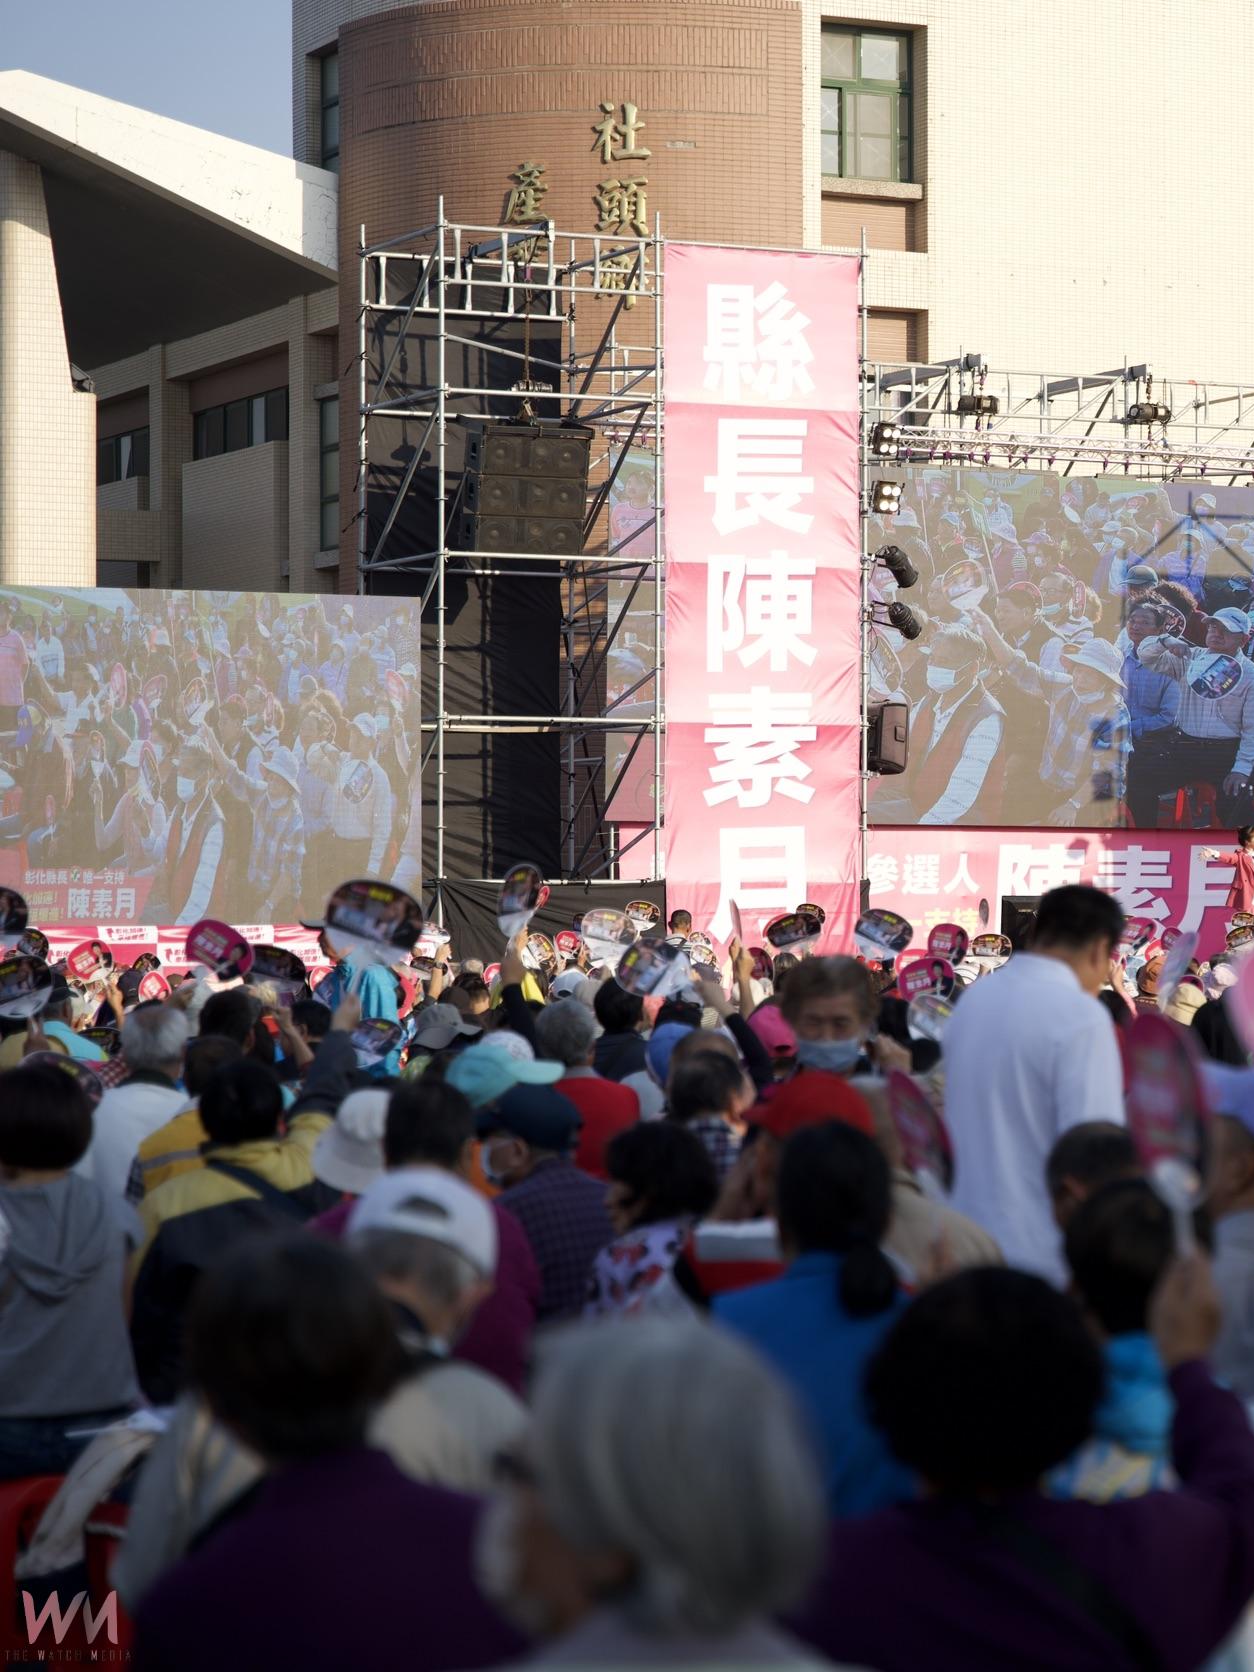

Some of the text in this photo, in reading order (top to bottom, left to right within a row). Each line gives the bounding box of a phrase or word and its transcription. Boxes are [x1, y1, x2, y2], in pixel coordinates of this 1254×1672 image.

[702, 280, 819, 944] 縣長陳素月
[866, 852, 981, 895] 參選人
[67, 888, 136, 919] 陳素月
